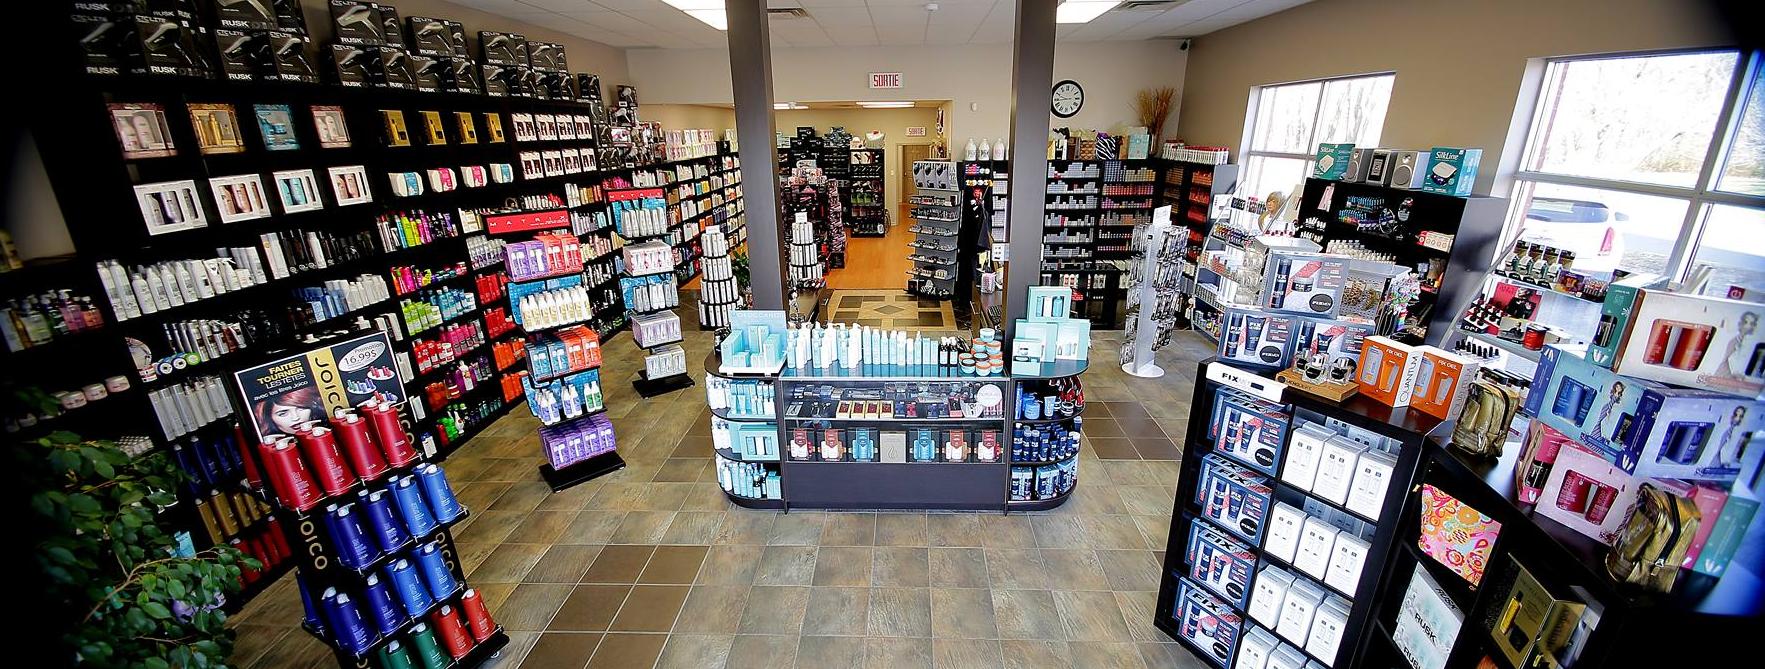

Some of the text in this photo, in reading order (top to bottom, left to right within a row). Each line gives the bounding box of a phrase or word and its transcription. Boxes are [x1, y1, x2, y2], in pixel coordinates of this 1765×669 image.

[75, 3, 110, 11] RUSK
[221, 19, 250, 28] RUSK
[85, 66, 120, 75] RUSK
[150, 66, 177, 74] RUSK
[873, 74, 899, 87] SORTIE
[908, 127, 924, 135] SORTIE
[1435, 151, 1459, 160] SilkLine
[490, 215, 565, 227] MATRIX
[344, 349, 377, 365] 16.99$
[268, 360, 302, 374] FAITES
[257, 366, 304, 384] TOURNER
[1222, 372, 1238, 382] FIX
[1400, 355, 1419, 402] QUANTUM
[254, 392, 269, 400] avec
[292, 380, 308, 389] Joico
[265, 379, 282, 389] LES
[1218, 469, 1247, 484] FIX
[1205, 532, 1233, 550] FIX
[435, 532, 455, 572] OICO
[1192, 592, 1219, 612] FIX
[1436, 587, 1457, 610] RUSK
[1414, 612, 1437, 644] RUSK
[1403, 646, 1421, 669] RUS
